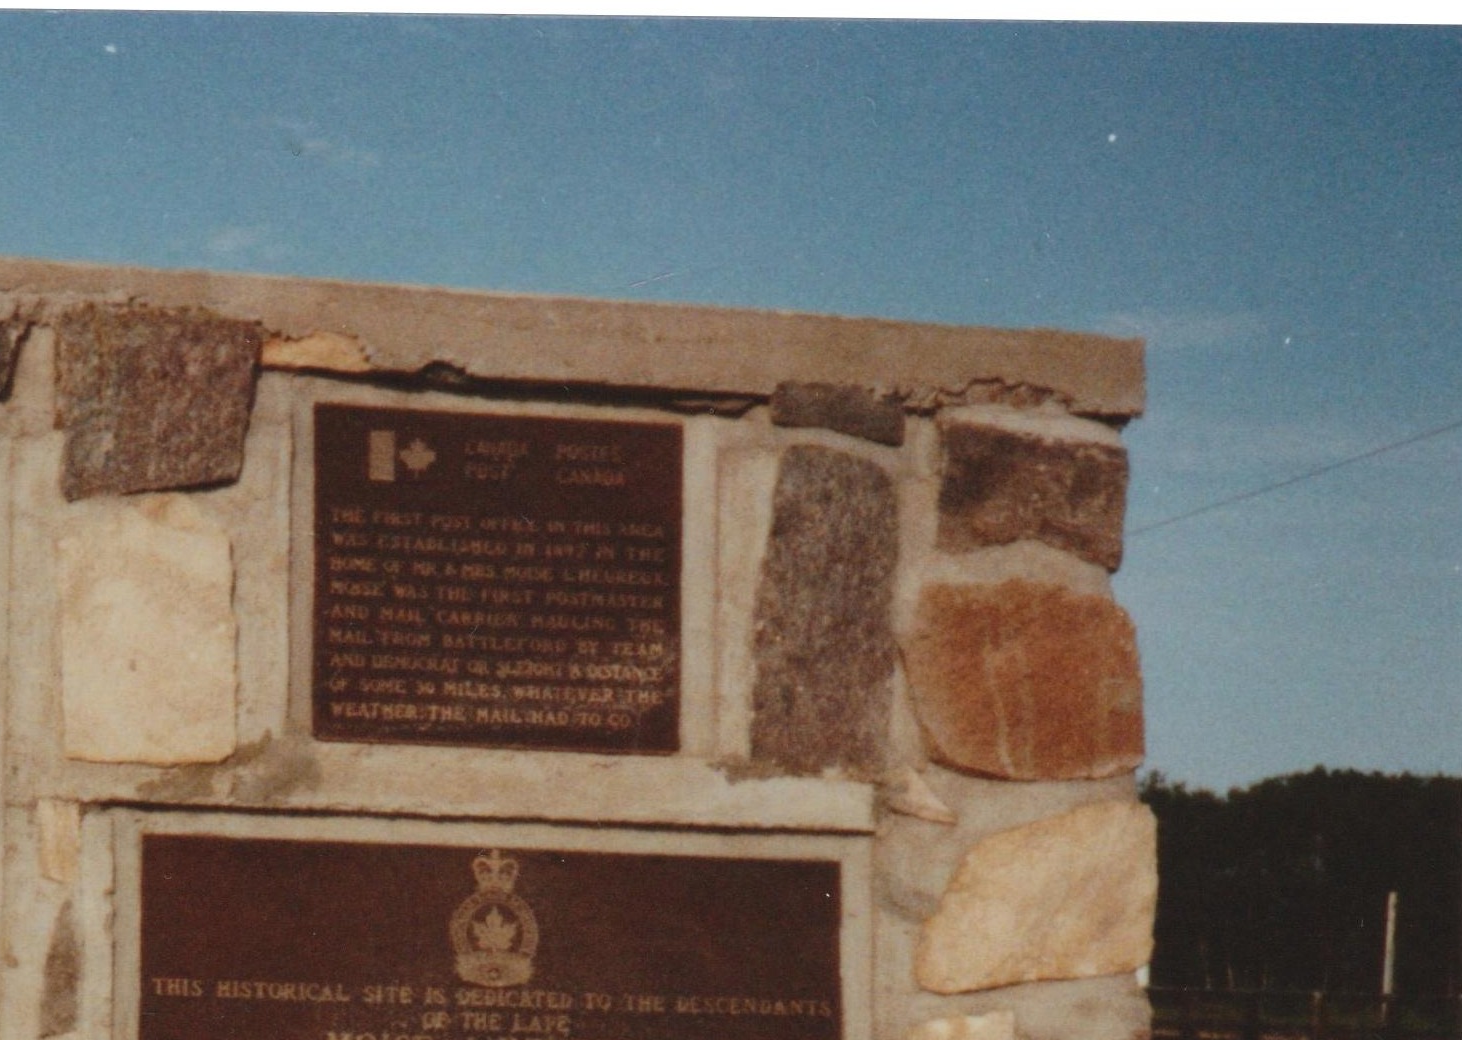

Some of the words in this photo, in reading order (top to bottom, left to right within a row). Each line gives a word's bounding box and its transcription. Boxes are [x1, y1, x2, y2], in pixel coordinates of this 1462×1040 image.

[332, 508, 365, 523] THE
[547, 518, 565, 533] IN
[573, 519, 610, 535] THIS
[515, 541, 535, 556] IN
[628, 546, 664, 562] THE
[330, 557, 375, 573] HOME
[382, 559, 402, 574] OF
[394, 584, 428, 599] WAS
[436, 586, 470, 601] THE
[480, 588, 533, 603] FIRST
[545, 590, 663, 609] POSTMASTER
[329, 604, 368, 621] AND
[379, 606, 425, 624] MAIL
[436, 609, 517, 628] CARRIER
[627, 617, 663, 634] THE
[329, 629, 371, 645] MAIL
[380, 631, 431, 647] FROM
[442, 634, 566, 653] BATTLEFORD
[577, 640, 598, 654] BY
[612, 641, 662, 657] TEAM
[329, 652, 365, 669] AND
[584, 663, 661, 681] DISTANCE
[329, 676, 346, 691] OF
[358, 677, 407, 694] SOME
[512, 683, 612, 702] WHATEVER
[624, 688, 662, 704] THE
[430, 705, 465, 722] THE
[475, 707, 521, 724] MAIL
[530, 709, 568, 726] HAD
[578, 711, 600, 727] TO
[152, 978, 202, 998] THIS
[216, 980, 350, 1002] HISTORICAL
[363, 985, 412, 1004] SITE
[423, 987, 447, 1005] IS
[456, 988, 573, 1009] DEDICATED
[585, 992, 611, 1010] TO
[623, 993, 665, 1012] THE
[676, 995, 832, 1017] DESCENDANTS
[421, 1010, 449, 1030] OF
[460, 1011, 500, 1032] THE
[511, 1013, 570, 1034] LATE
